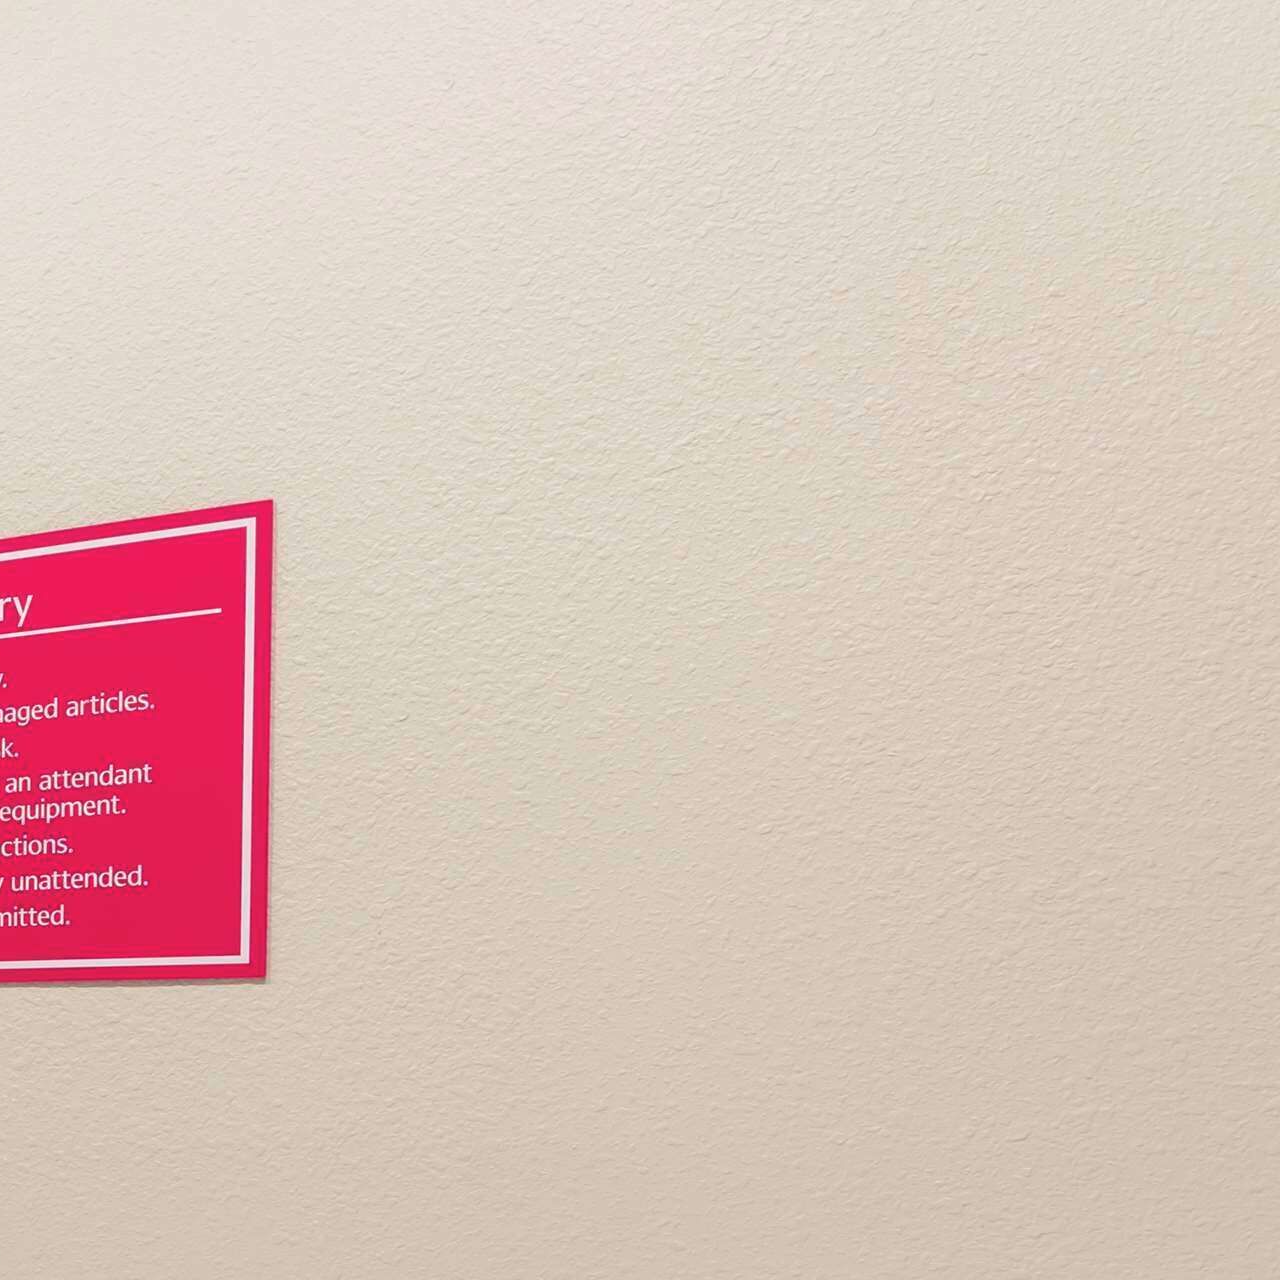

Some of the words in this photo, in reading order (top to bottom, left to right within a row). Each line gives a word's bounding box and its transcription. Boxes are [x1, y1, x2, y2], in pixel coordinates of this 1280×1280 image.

[66, 691, 154, 716] articles.
[5, 776, 31, 793] an
[39, 764, 152, 790] attendant
[0, 796, 126, 825] equipment.
[12, 865, 148, 891] unattended.
